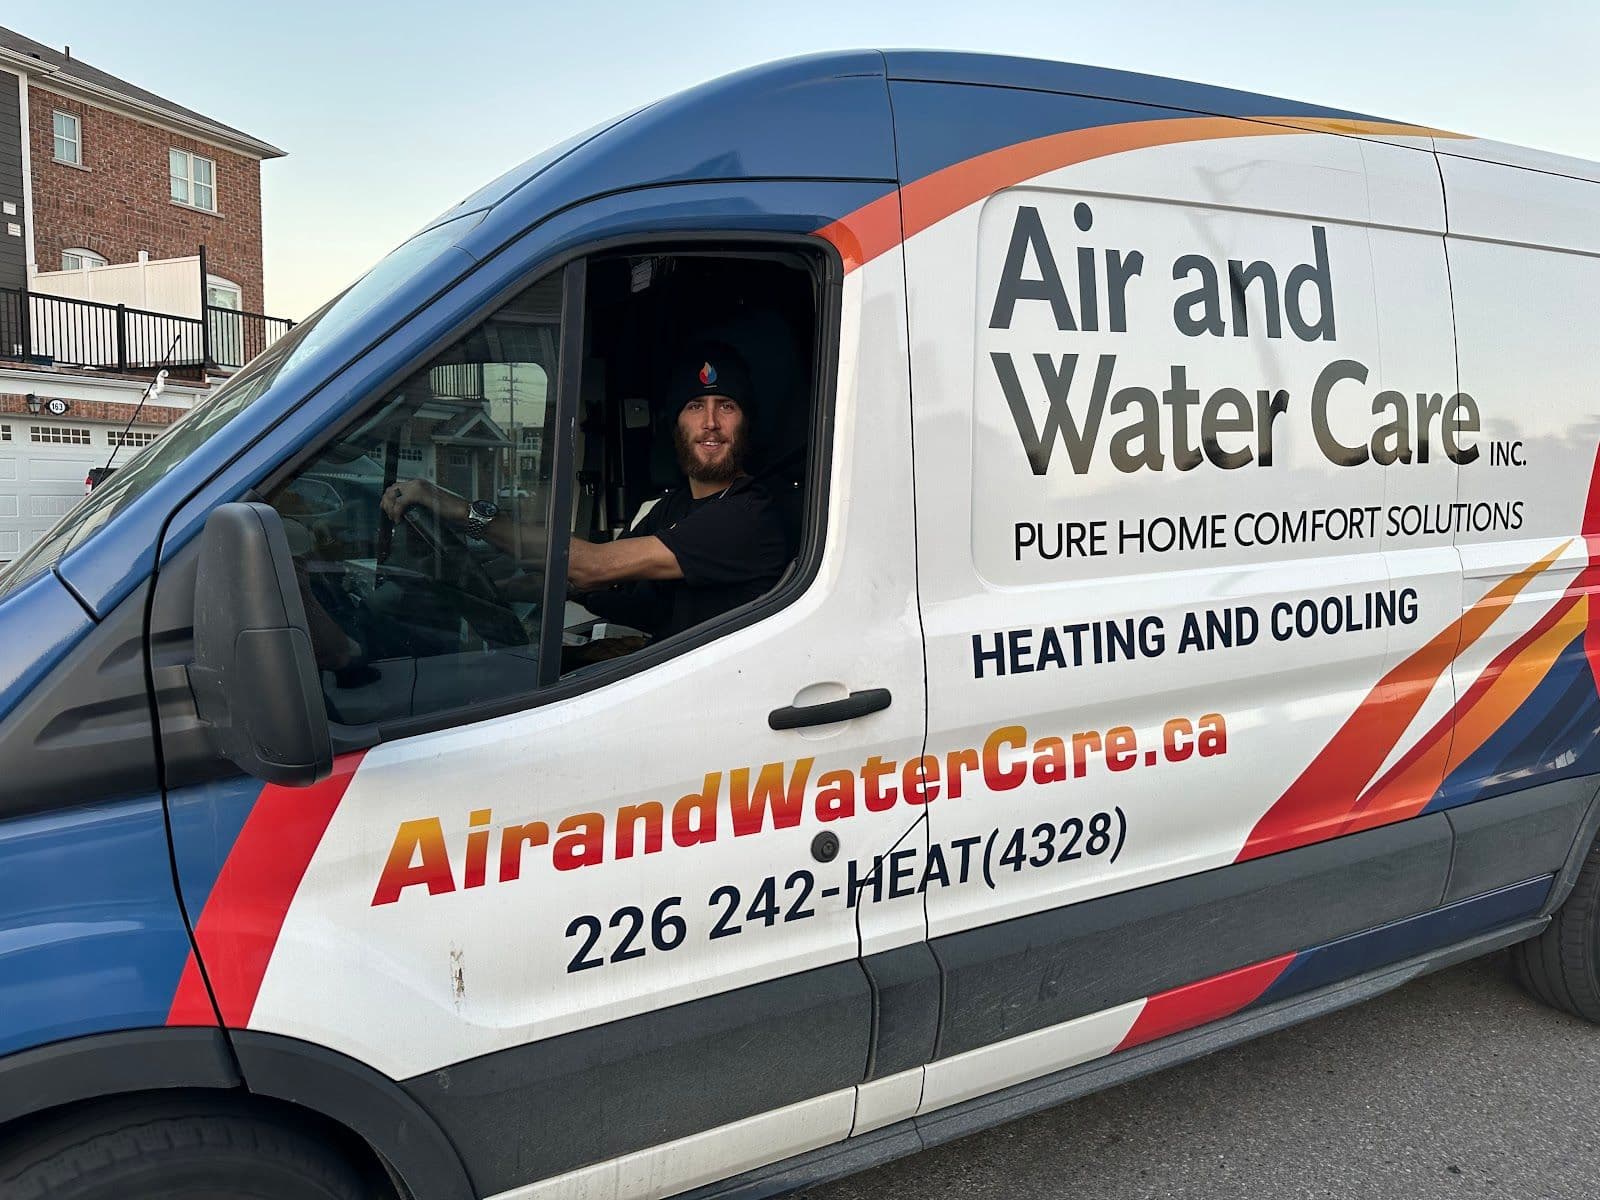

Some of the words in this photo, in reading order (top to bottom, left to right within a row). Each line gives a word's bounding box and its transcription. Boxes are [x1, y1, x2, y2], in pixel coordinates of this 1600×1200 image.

[989, 202, 1144, 333] Air
[1172, 225, 1337, 342] and
[989, 351, 1289, 476] Water
[1310, 359, 1481, 467] Care
[1490, 441, 1527, 467] INC.
[1014, 521, 1108, 561] PURE
[1118, 514, 1228, 555] HOME
[1234, 507, 1381, 547] COMFORT
[1386, 501, 1524, 537] SOLUTIONS
[972, 615, 1165, 679] HEATING
[1177, 606, 1259, 654] AND
[1271, 587, 1418, 641] COOLING
[371, 711, 1228, 907] AirandWaterCare.ca
[565, 897, 687, 974] 226
